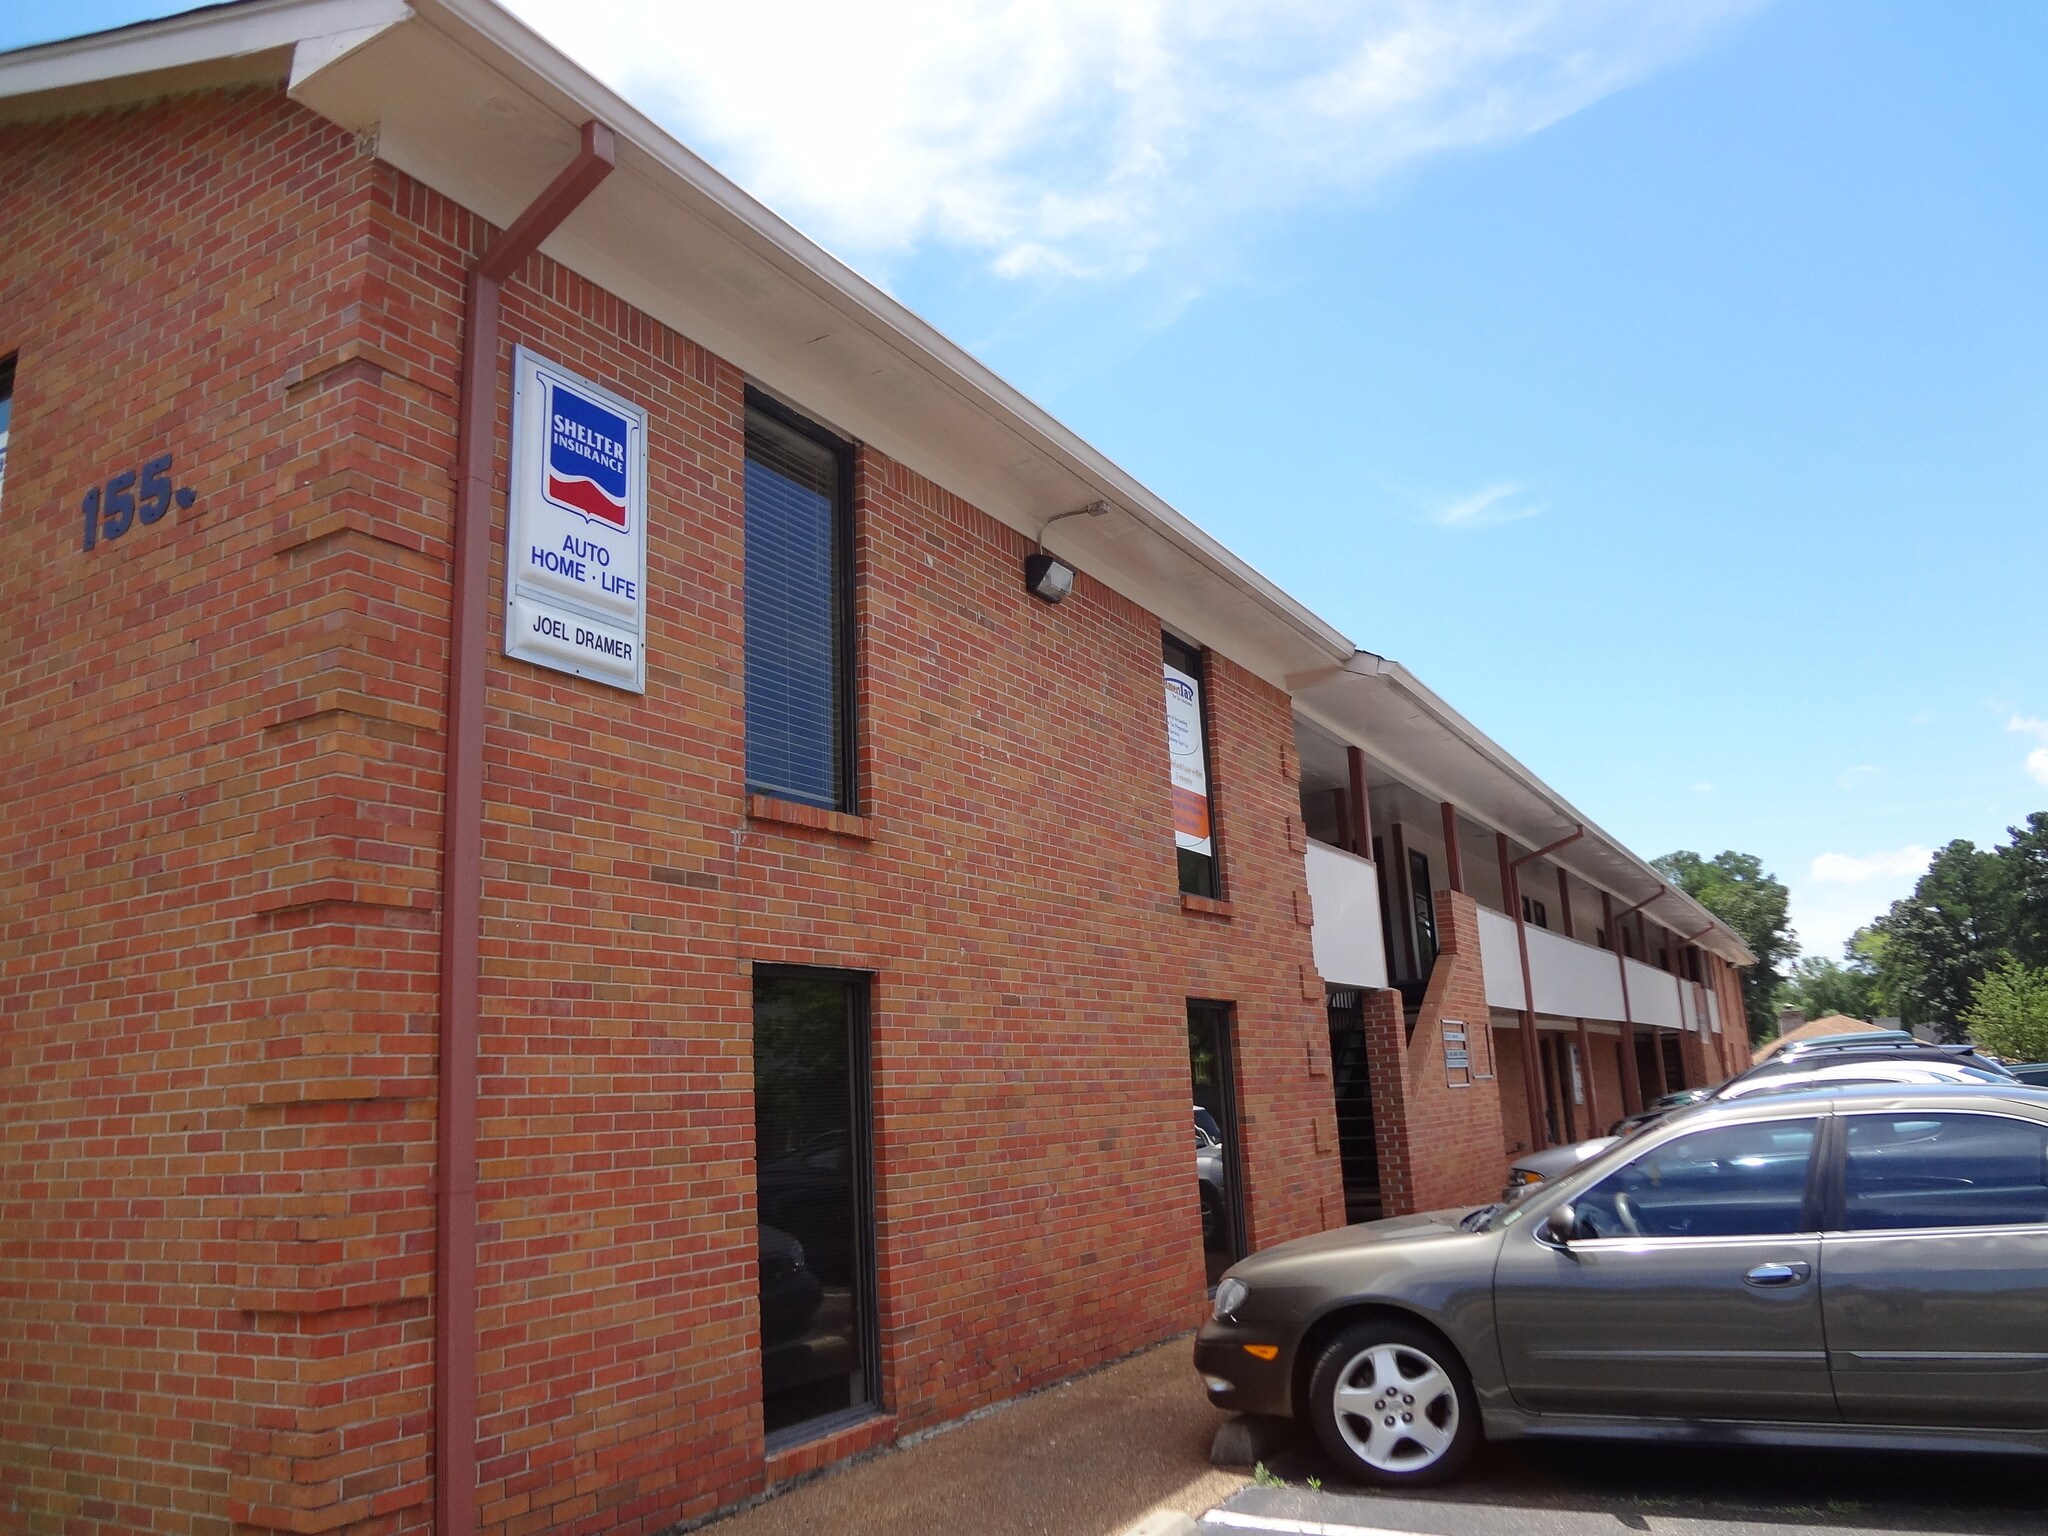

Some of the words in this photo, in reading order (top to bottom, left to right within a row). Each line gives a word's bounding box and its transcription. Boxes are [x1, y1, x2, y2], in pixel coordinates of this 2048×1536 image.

[553, 414, 624, 461] SHELTER
[553, 432, 624, 474] INSURANCE
[531, 545, 586, 583] HOME
[601, 571, 636, 600] LIFE
[562, 534, 610, 567] AUTO
[533, 615, 570, 642] JOEL
[575, 627, 632, 661] DRAMER
